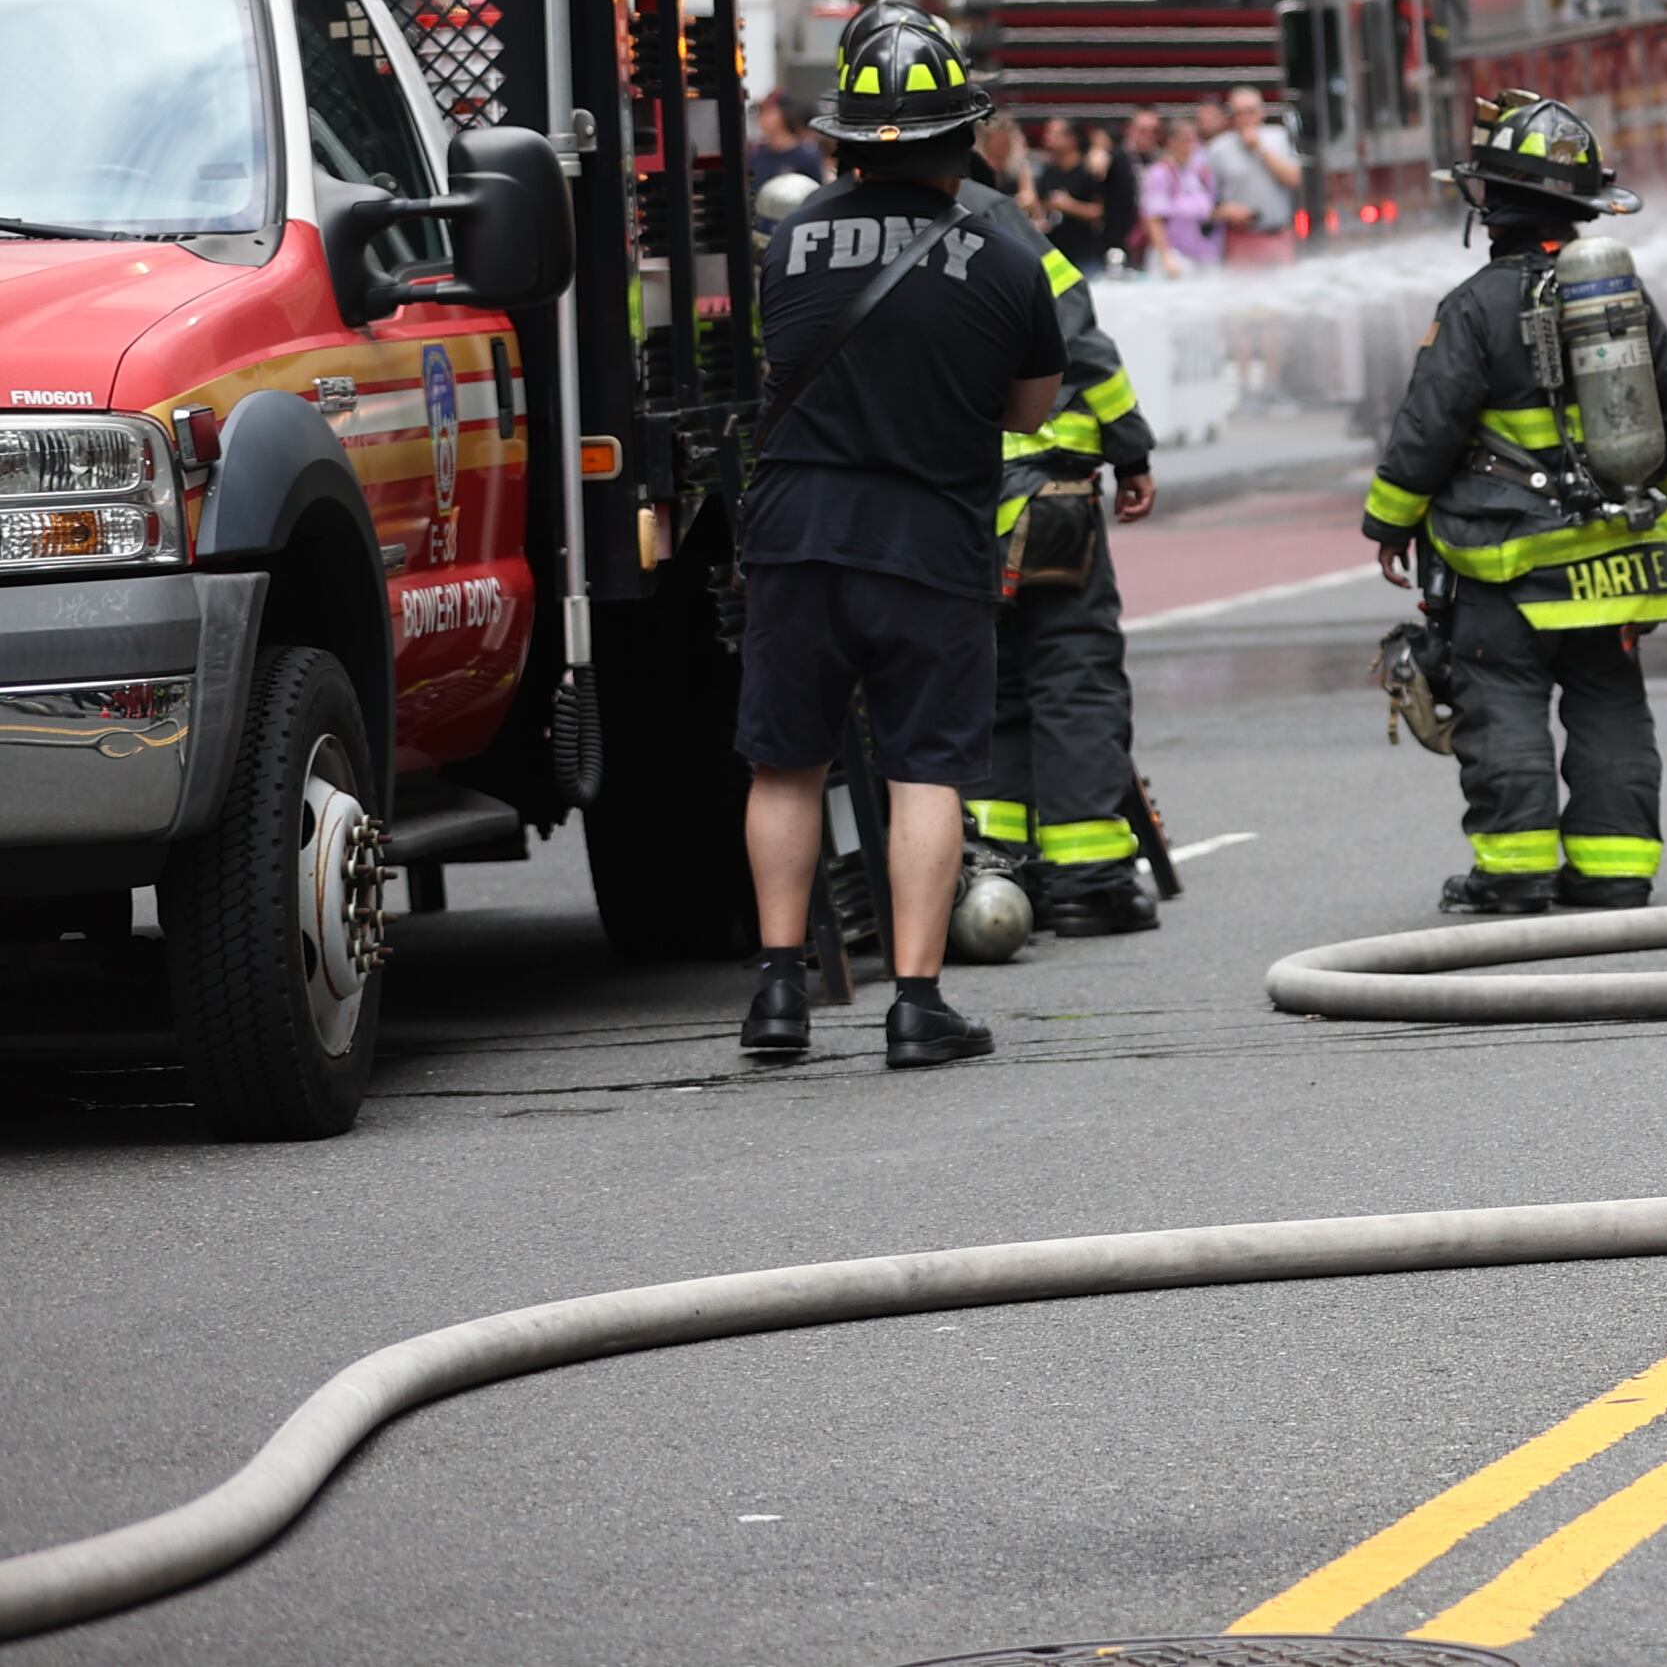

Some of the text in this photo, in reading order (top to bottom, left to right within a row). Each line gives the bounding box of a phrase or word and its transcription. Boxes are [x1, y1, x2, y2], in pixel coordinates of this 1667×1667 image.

[786, 216, 985, 280] FDNY
[10, 390, 93, 406] FM06011
[402, 576, 501, 639] BOWERY BOYS
